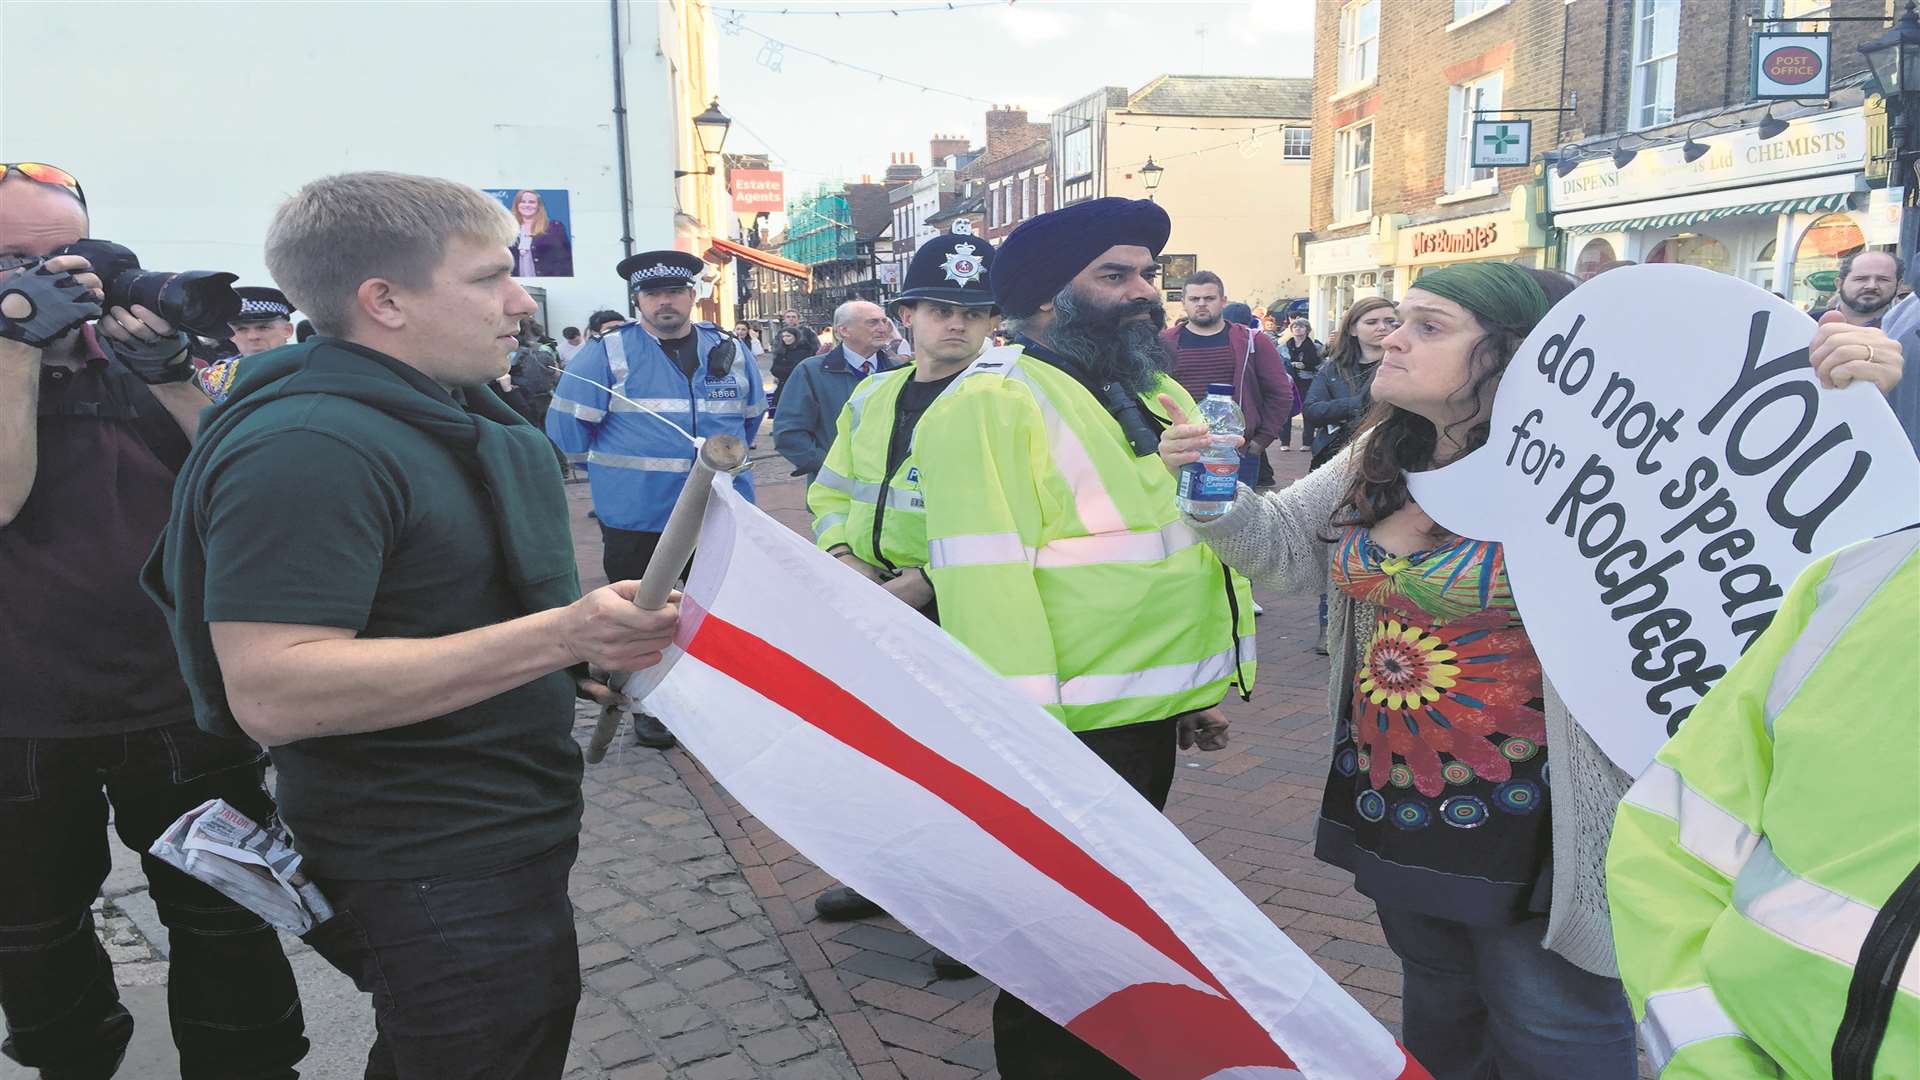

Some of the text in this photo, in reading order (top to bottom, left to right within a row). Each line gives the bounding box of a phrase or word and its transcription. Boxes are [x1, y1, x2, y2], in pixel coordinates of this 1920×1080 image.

[1776, 56, 1808, 66] POST
[1771, 66, 1814, 76] OFFICE
[1746, 130, 1846, 164] CHEMISTS
[735, 179, 781, 191] Estate
[735, 191, 782, 204] Agents
[1537, 314, 1595, 396] do
[1591, 370, 1685, 476] not
[1506, 408, 1727, 740] for Rochest
